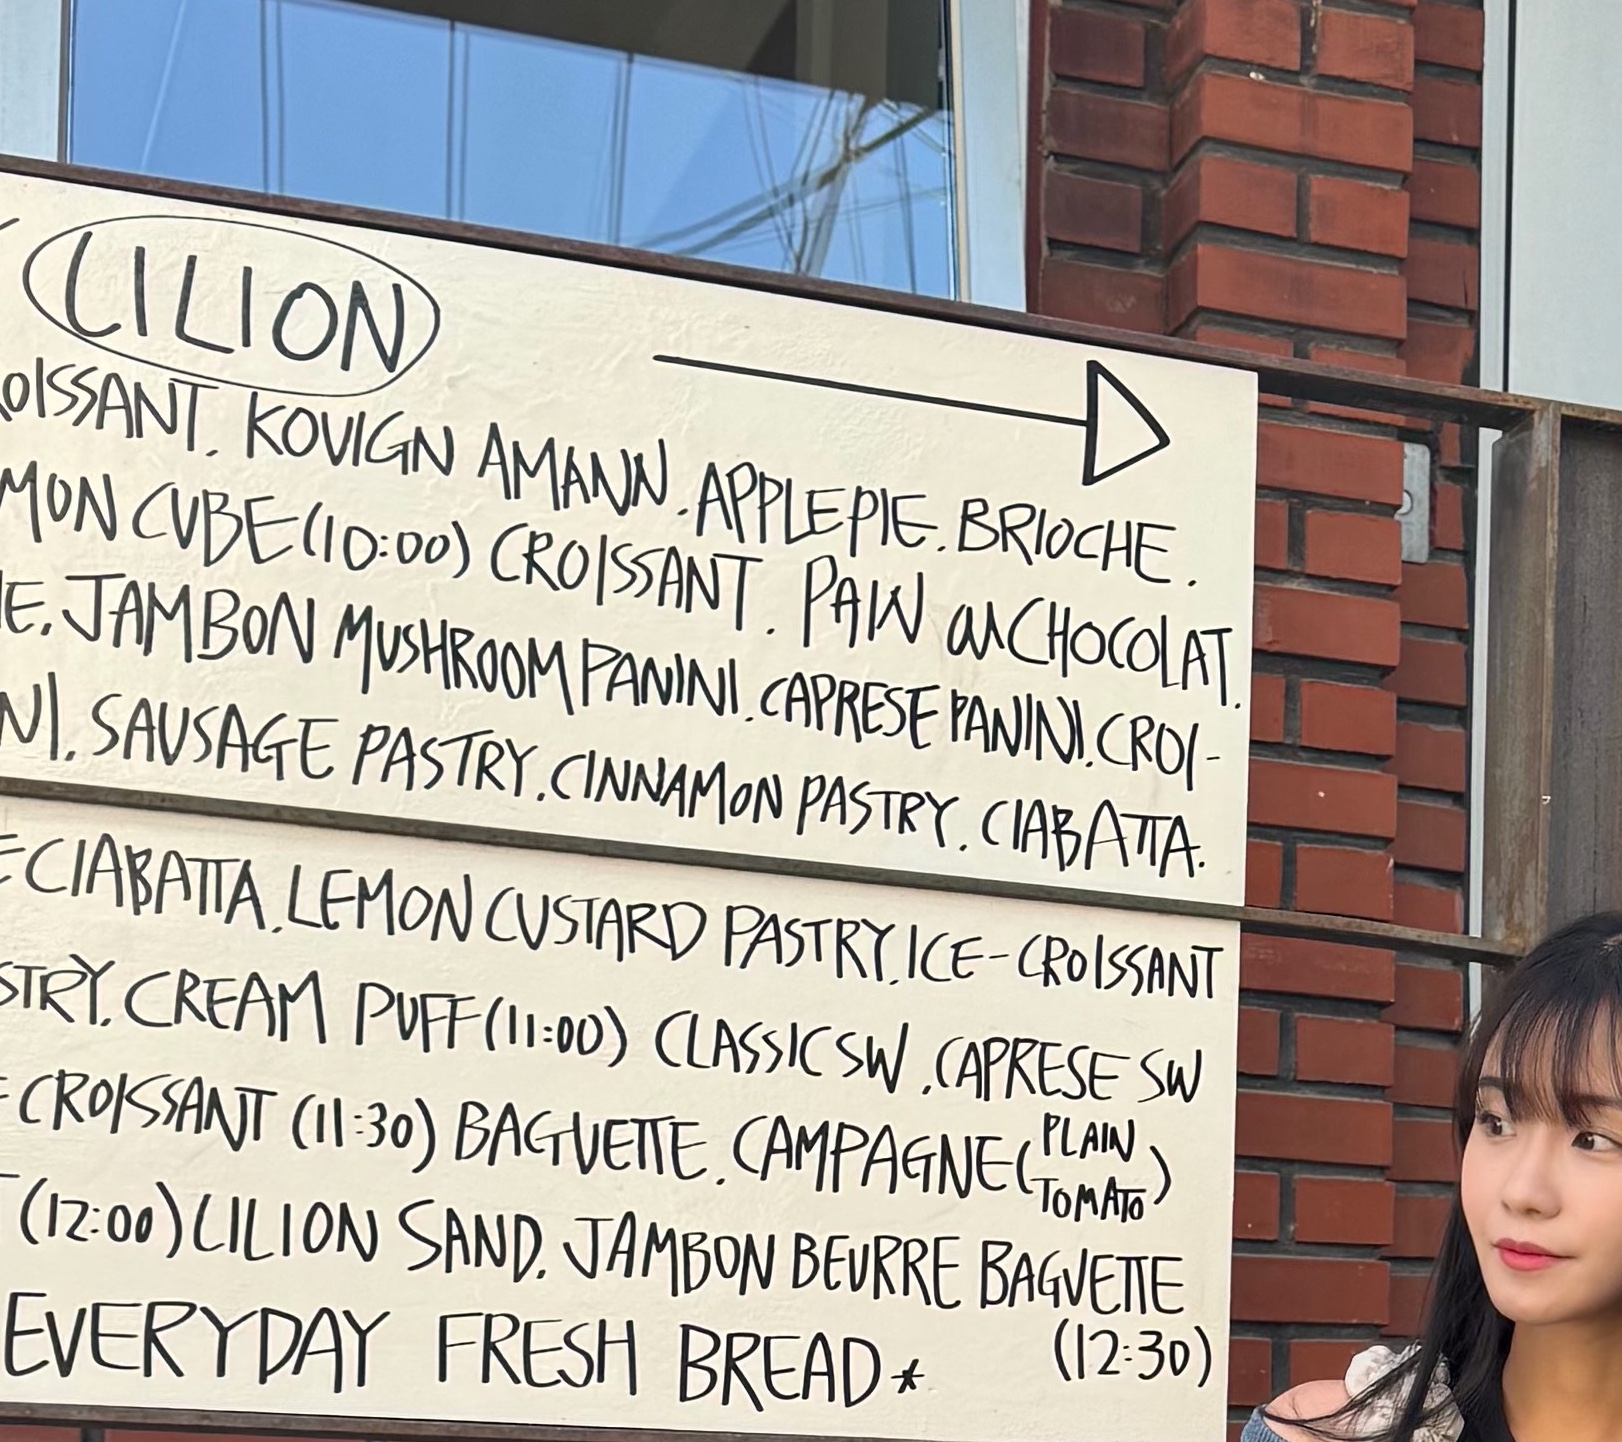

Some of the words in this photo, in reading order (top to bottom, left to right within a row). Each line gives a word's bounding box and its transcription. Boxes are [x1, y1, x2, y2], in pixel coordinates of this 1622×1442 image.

[65, 231, 405, 372] LILION
[802, 554, 924, 648] PAIN
[0, 570, 51, 635] E.
[62, 574, 314, 663] JAMBON
[334, 604, 574, 715] MUSHROOM
[760, 671, 940, 749] CAPRESE
[92, 693, 340, 781] SAUSAGE
[549, 753, 782, 824] CINNAMON
[287, 864, 471, 942] LEMON
[484, 886, 707, 961] CUSTARD
[125, 968, 327, 1045] CREAM
[355, 980, 481, 1053] PUFF
[1137, 1047, 1203, 1103] SW
[19, 1069, 278, 1151] CROISSANT
[291, 1094, 436, 1175] (11:30)
[1042, 1112, 1136, 1162] PLAIN
[192, 1194, 378, 1264] LILION
[563, 1211, 775, 1297] JAMBON
[791, 1232, 961, 1308] BEURRE
[980, 1239, 1185, 1315] BAGUETTE
[1031, 1176, 1147, 1224] TOMATO
[3, 1291, 391, 1393] EVERYDAY
[437, 1313, 637, 1396] FRESH
[679, 1324, 882, 1412] BREAD
[1054, 1318, 1212, 1388] (12:30)
